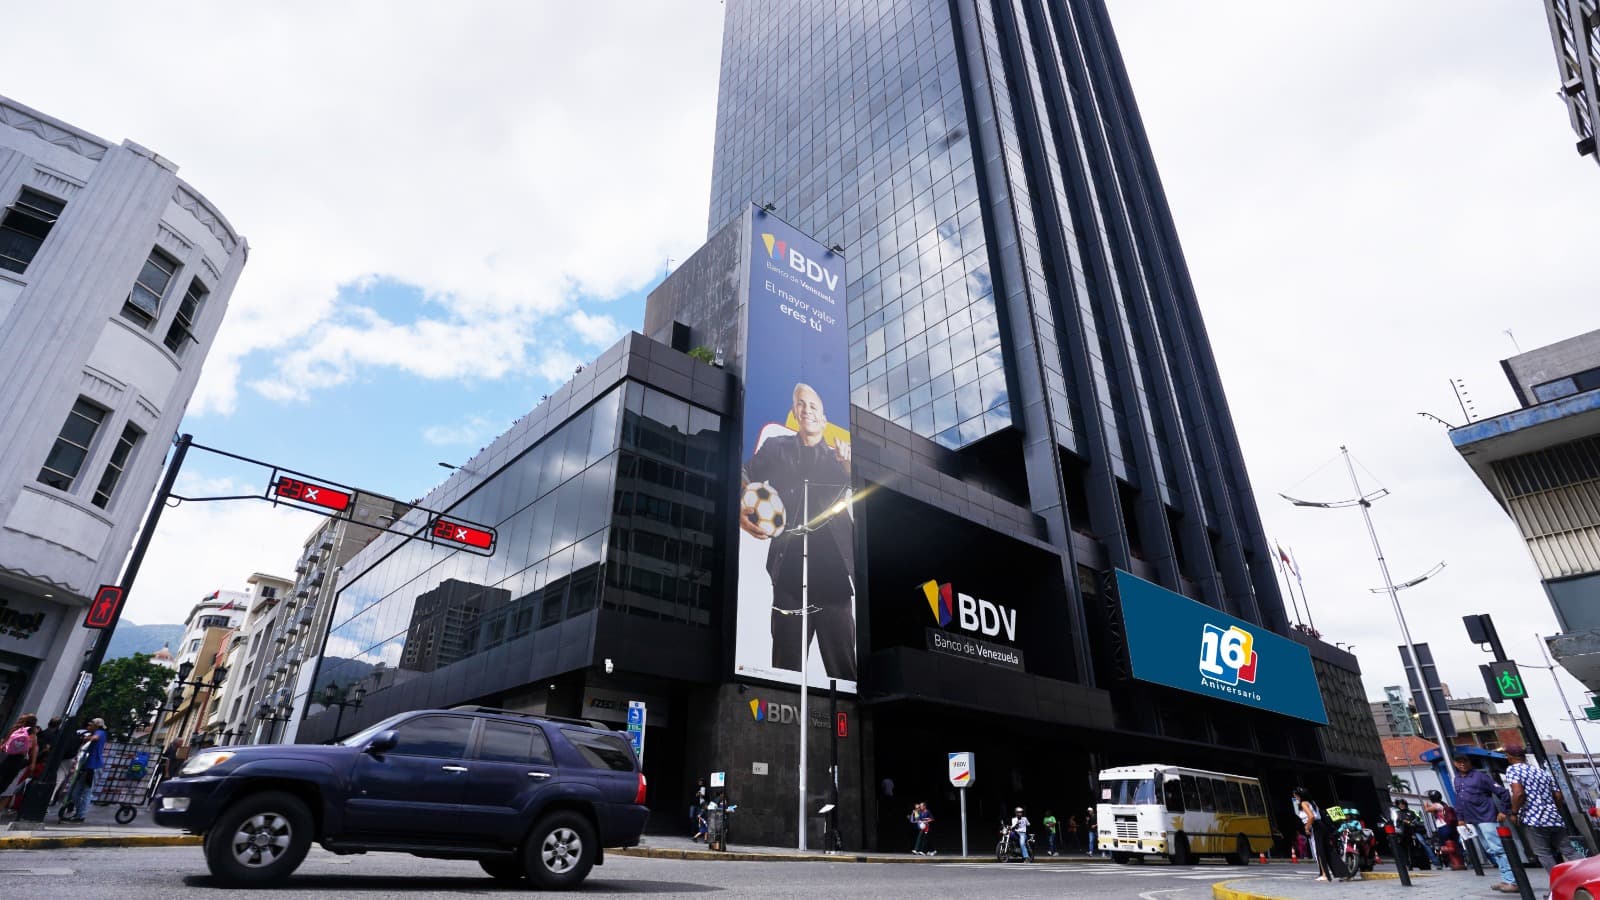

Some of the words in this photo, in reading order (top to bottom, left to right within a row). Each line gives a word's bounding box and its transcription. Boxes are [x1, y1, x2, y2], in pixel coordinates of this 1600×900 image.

[766, 260, 789, 278] Banco
[800, 280, 836, 305] Venezuela
[789, 247, 839, 292] BDV
[765, 280, 776, 294] El
[778, 289, 810, 311] mayor
[812, 307, 836, 326] valor
[780, 304, 807, 324] eres
[809, 317, 822, 332] tú
[278, 478, 304, 499] 23
[433, 520, 455, 539] 23
[957, 592, 1017, 642] BDV
[934, 633, 962, 652] Banco
[963, 642, 975, 655] de
[975, 644, 1019, 665] Venezuela
[1200, 629, 1247, 675] 16
[1201, 677, 1261, 701] Aniversario
